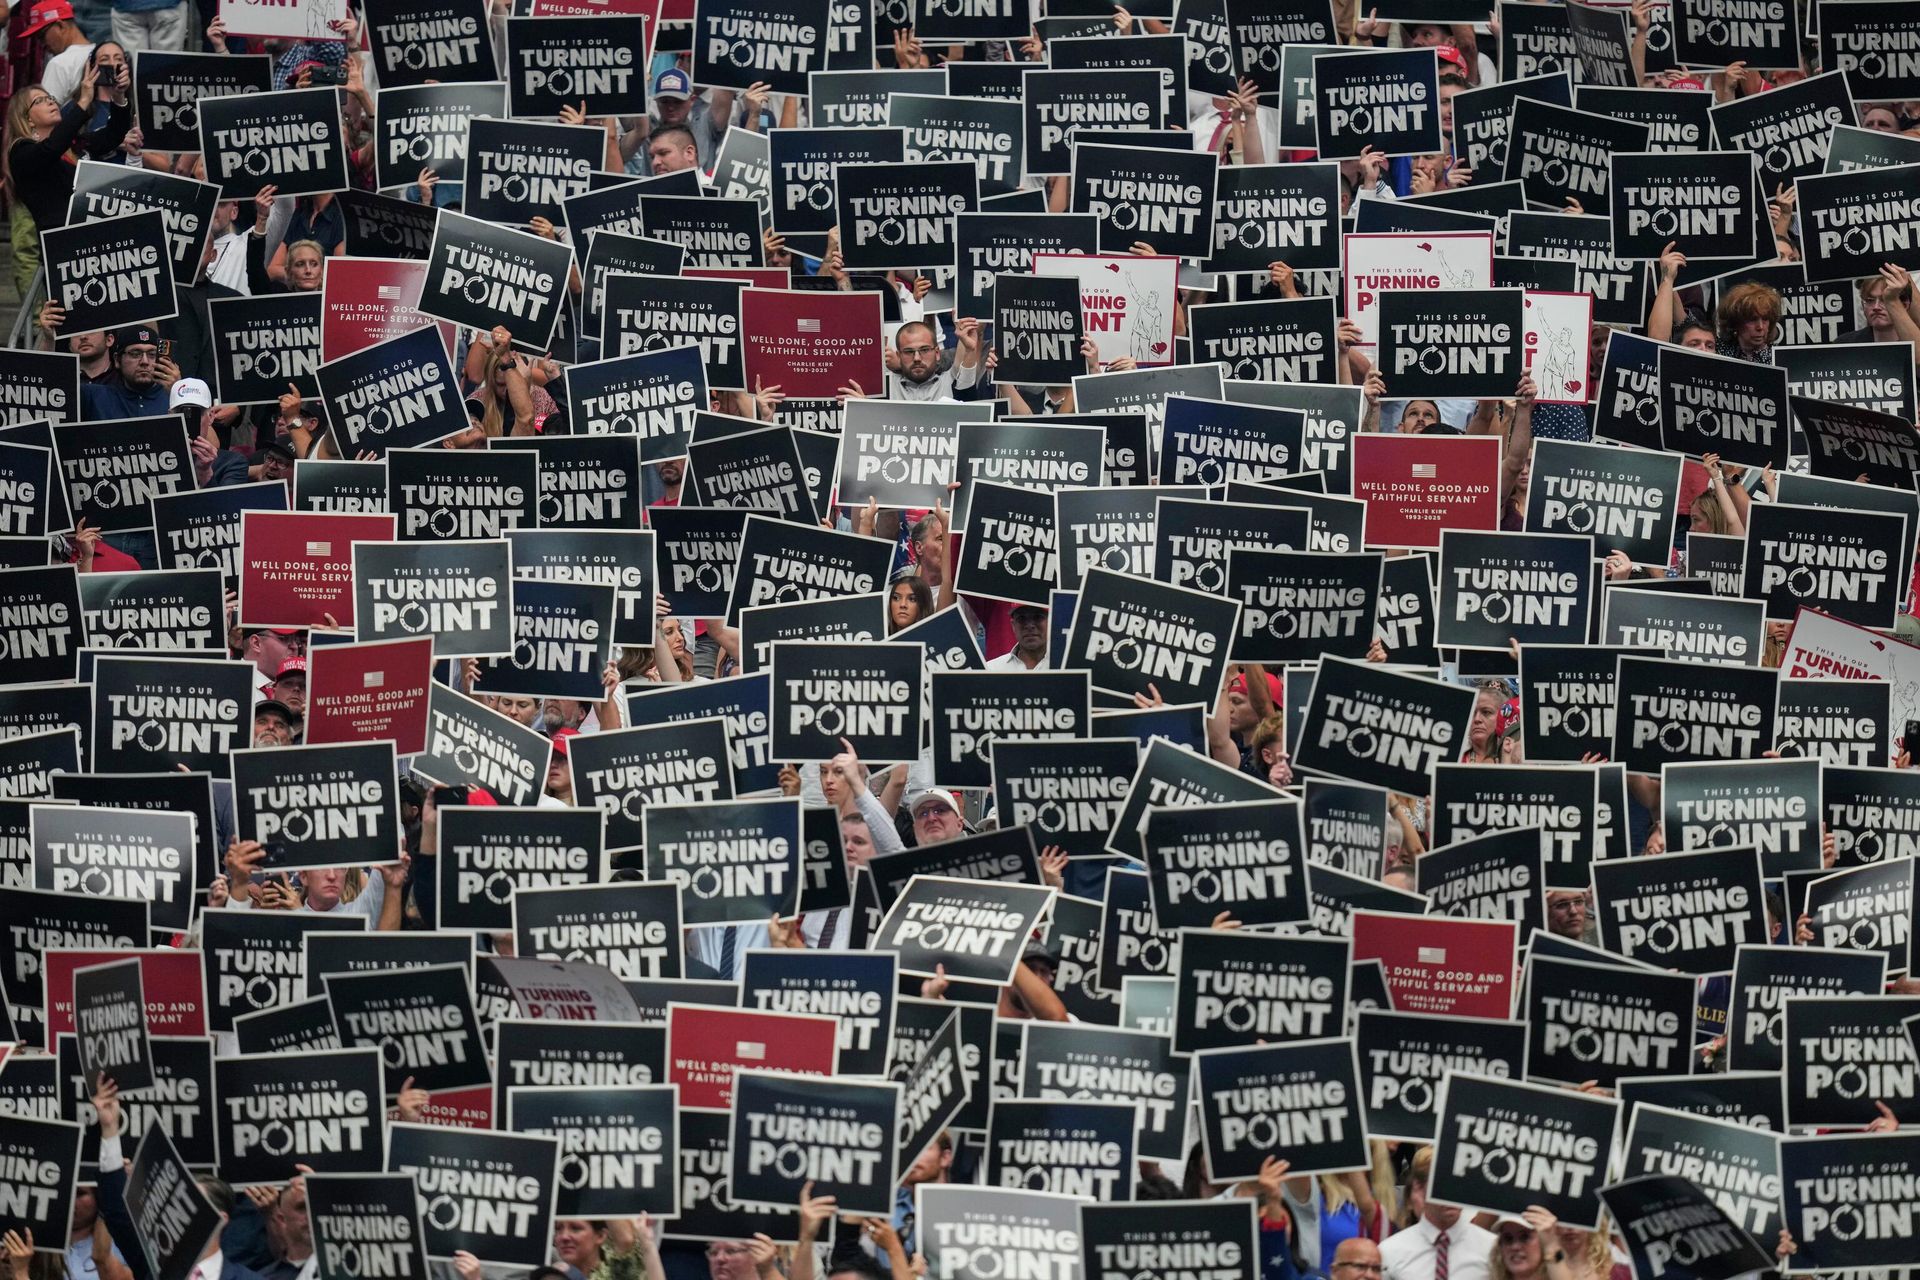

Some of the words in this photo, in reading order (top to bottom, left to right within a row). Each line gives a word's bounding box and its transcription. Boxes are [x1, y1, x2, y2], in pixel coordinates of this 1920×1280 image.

[706, 16, 816, 44] TURNING
[519, 46, 632, 67] TURNING
[707, 37, 814, 74] POINT
[524, 67, 633, 95] POINT
[1325, 81, 1426, 106] TURNING
[282, 113, 303, 121] OUR
[1330, 103, 1427, 135] POINT
[213, 120, 328, 149] TURNING
[220, 142, 330, 178] POINT
[1086, 178, 1202, 204] TURNING
[1623, 184, 1740, 206] TURNING
[1087, 200, 1201, 235] POINT
[1628, 206, 1740, 236] POINT
[56, 244, 158, 281] TURNING
[445, 244, 553, 292] TURNING
[62, 266, 160, 311] POINT
[439, 266, 549, 322] POINT
[340, 314, 385, 322] FAITHFUL
[390, 315, 432, 324] SERVAN
[358, 304, 388, 313] DONE,
[750, 335, 774, 344] WELL
[778, 337, 809, 346] DONE,
[850, 337, 873, 345] AND
[1391, 323, 1510, 344] TURNING
[760, 346, 808, 355] FAITHFUL
[1394, 344, 1510, 374] POINT
[334, 361, 440, 414] TURNING
[352, 374, 374, 386] THIS
[393, 359, 412, 370] OUR
[344, 382, 445, 443] POINT
[1670, 383, 1776, 417] TURNING
[1674, 404, 1777, 446] POINT
[1361, 481, 1386, 490] WELL
[1391, 483, 1424, 493] DONE,
[1466, 484, 1489, 492] AND
[1372, 492, 1422, 502] FAITHFUL
[1543, 476, 1663, 508] TURNING
[1542, 499, 1661, 540] POINT
[1788, 532, 1814, 540] THIS
[1840, 536, 1863, 544] OUR
[252, 561, 279, 569] WELL
[285, 562, 319, 571] DONE,
[324, 563, 352, 571] GOO
[1481, 558, 1507, 566] THIS
[1760, 540, 1887, 570] TURNING
[263, 572, 317, 581] FAITHFUL
[322, 574, 352, 582] SERV
[368, 576, 497, 600] TURNING
[1453, 567, 1577, 593] TURNING
[1760, 564, 1886, 603] POINT
[1240, 586, 1365, 607] TURNING
[1455, 590, 1577, 626] POINT
[373, 600, 497, 632] POINT
[1120, 602, 1146, 613] THIS
[1171, 614, 1194, 624] OUR
[1243, 607, 1364, 638] POINT
[1091, 605, 1216, 653] TURNING
[1085, 630, 1212, 686] POINT
[1816, 646, 1834, 657] THIS
[1851, 659, 1868, 668] OUR
[316, 695, 341, 704] WELL
[377, 691, 403, 700] GOOD
[406, 688, 423, 697] AND
[786, 679, 909, 702] TURNING
[108, 695, 238, 720] TURNING
[327, 705, 372, 716] FAITHFUL
[376, 699, 414, 712] SERVANT
[790, 702, 909, 736] POINT
[1630, 695, 1761, 726] TURNING
[111, 718, 238, 754] POINT
[432, 708, 535, 778] TURNING
[1632, 719, 1760, 758] POINT
[432, 730, 532, 803] POINT
[248, 779, 382, 809] TURNING
[255, 805, 384, 843] POINT
[1159, 839, 1290, 869] TURNING
[1166, 866, 1292, 902] POINT
[1610, 885, 1748, 922] TURNING
[1619, 911, 1750, 956] POINT
[1193, 970, 1332, 1000] TURNING
[1434, 982, 1489, 994] SERVANT
[1436, 971, 1474, 982] GOOD
[1477, 974, 1504, 983] AND
[517, 988, 592, 1002] TURNING
[1194, 996, 1331, 1036] POINT
[1542, 998, 1678, 1035] TURNING
[1543, 1023, 1677, 1071] POINT
[254, 1083, 283, 1092] THIS
[311, 1080, 337, 1088] OUR
[226, 1089, 368, 1120] TURNING
[1488, 1108, 1517, 1120] THIS
[1545, 1118, 1571, 1129] OUR
[233, 1117, 369, 1156] POINT
[747, 1113, 882, 1147] TURNING
[1456, 1114, 1597, 1161] TURNING
[748, 1140, 880, 1186] POINT
[1452, 1142, 1594, 1198] POINT
[318, 1214, 410, 1239] TURNING
[324, 1240, 413, 1280] POINT
